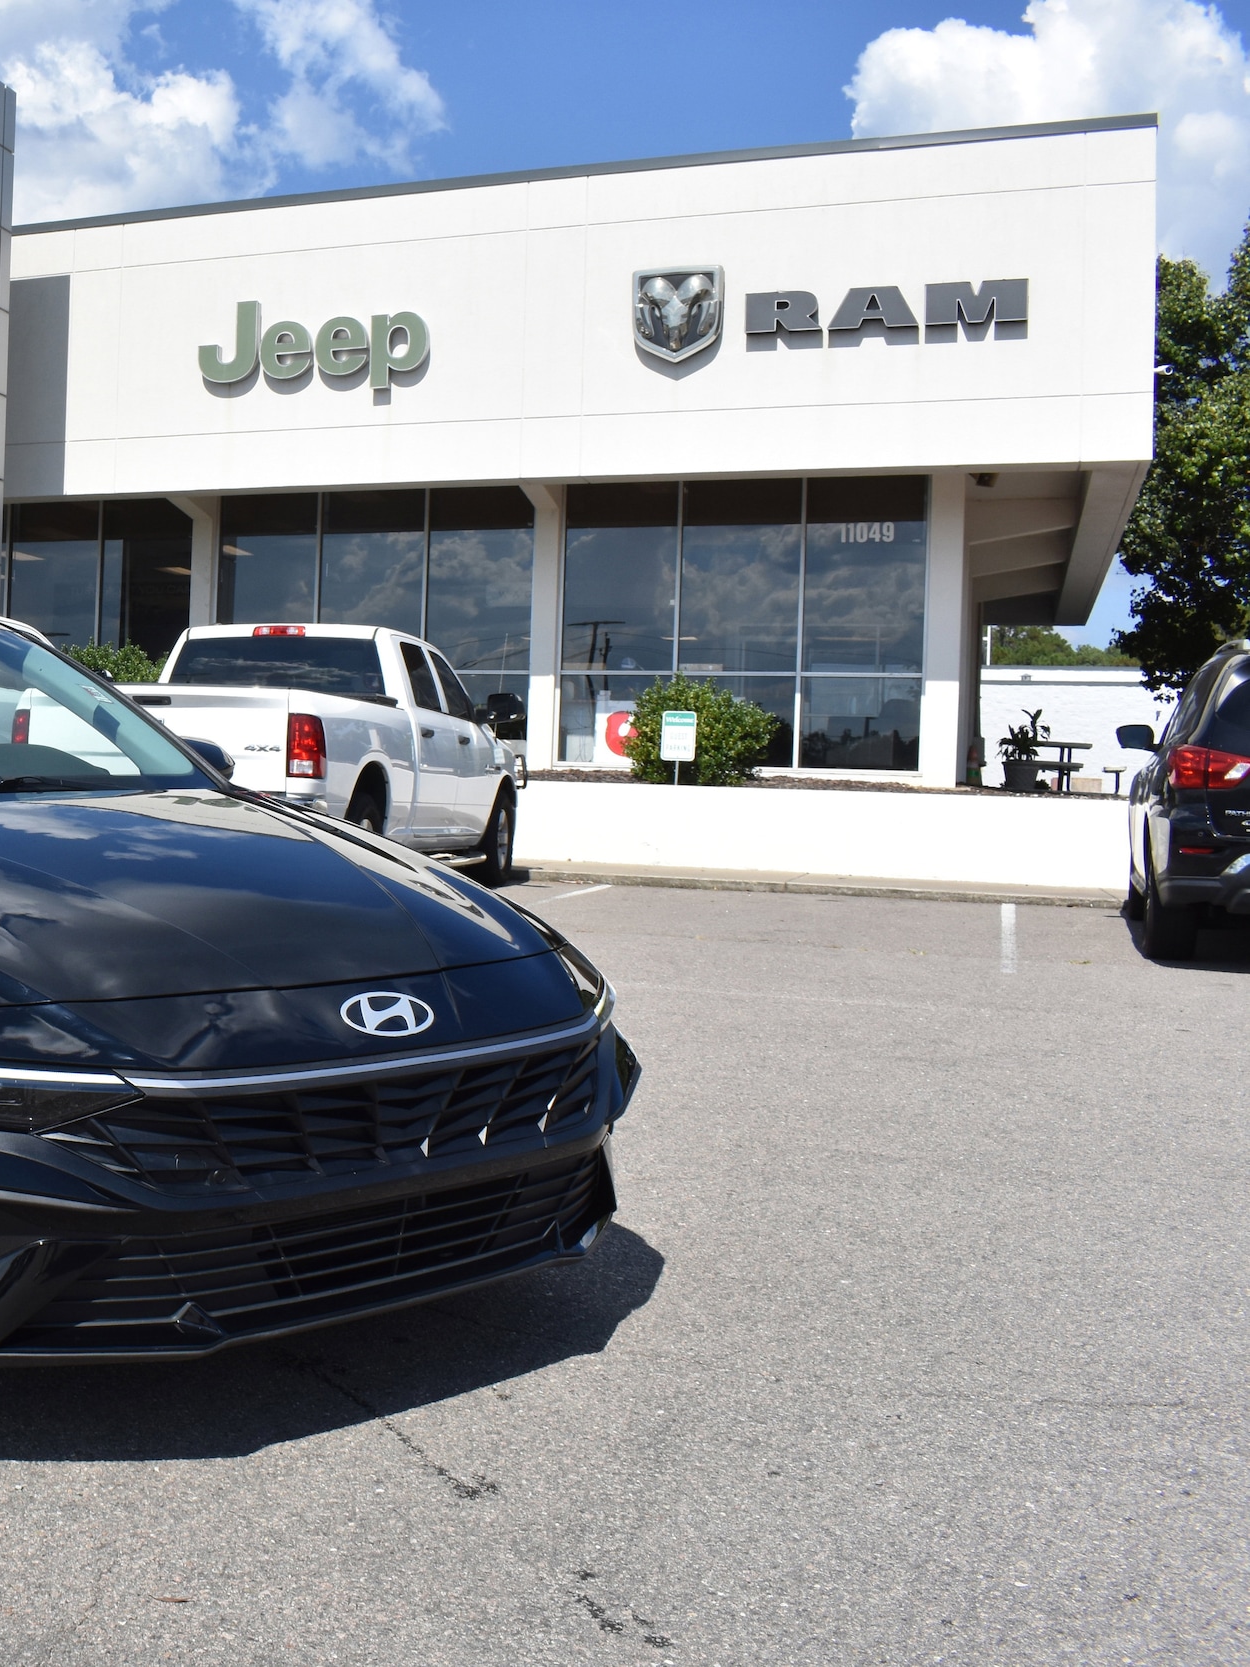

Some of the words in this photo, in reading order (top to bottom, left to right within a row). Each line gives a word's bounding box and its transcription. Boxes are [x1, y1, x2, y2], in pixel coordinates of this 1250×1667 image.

[745, 278, 1029, 334] RAM
[198, 300, 430, 390] Jeep
[840, 521, 895, 543] 11049
